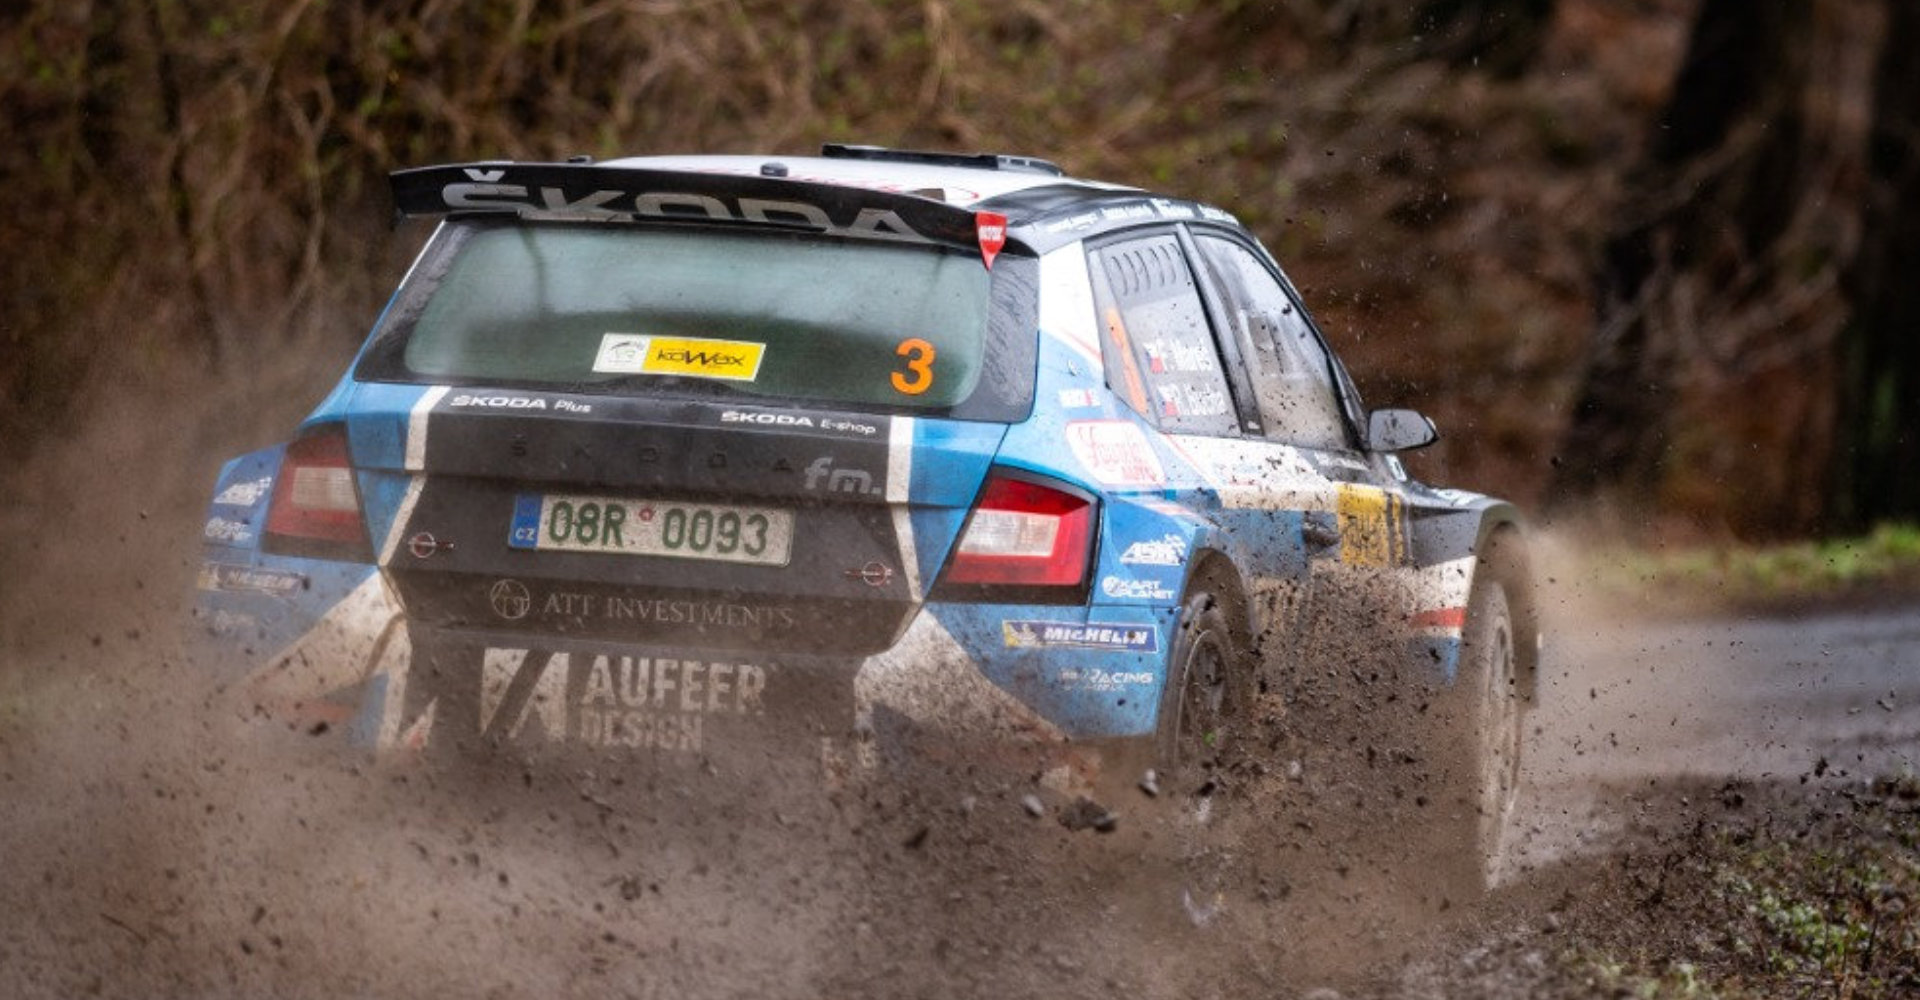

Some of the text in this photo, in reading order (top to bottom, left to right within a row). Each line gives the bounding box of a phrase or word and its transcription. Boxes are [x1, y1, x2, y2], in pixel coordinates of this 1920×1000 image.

[890, 338, 937, 395] 3
[553, 400, 592, 413] Plus
[820, 418, 877, 435] E-shop
[515, 527, 535, 541] CZ
[548, 500, 769, 556] 08R 0093
[544, 594, 595, 615] ATT
[607, 597, 793, 629] INVESTMENTS
[1043, 626, 1149, 645] MICHELIN
[580, 654, 765, 715] AUFEER
[580, 706, 702, 750] DESIGN
